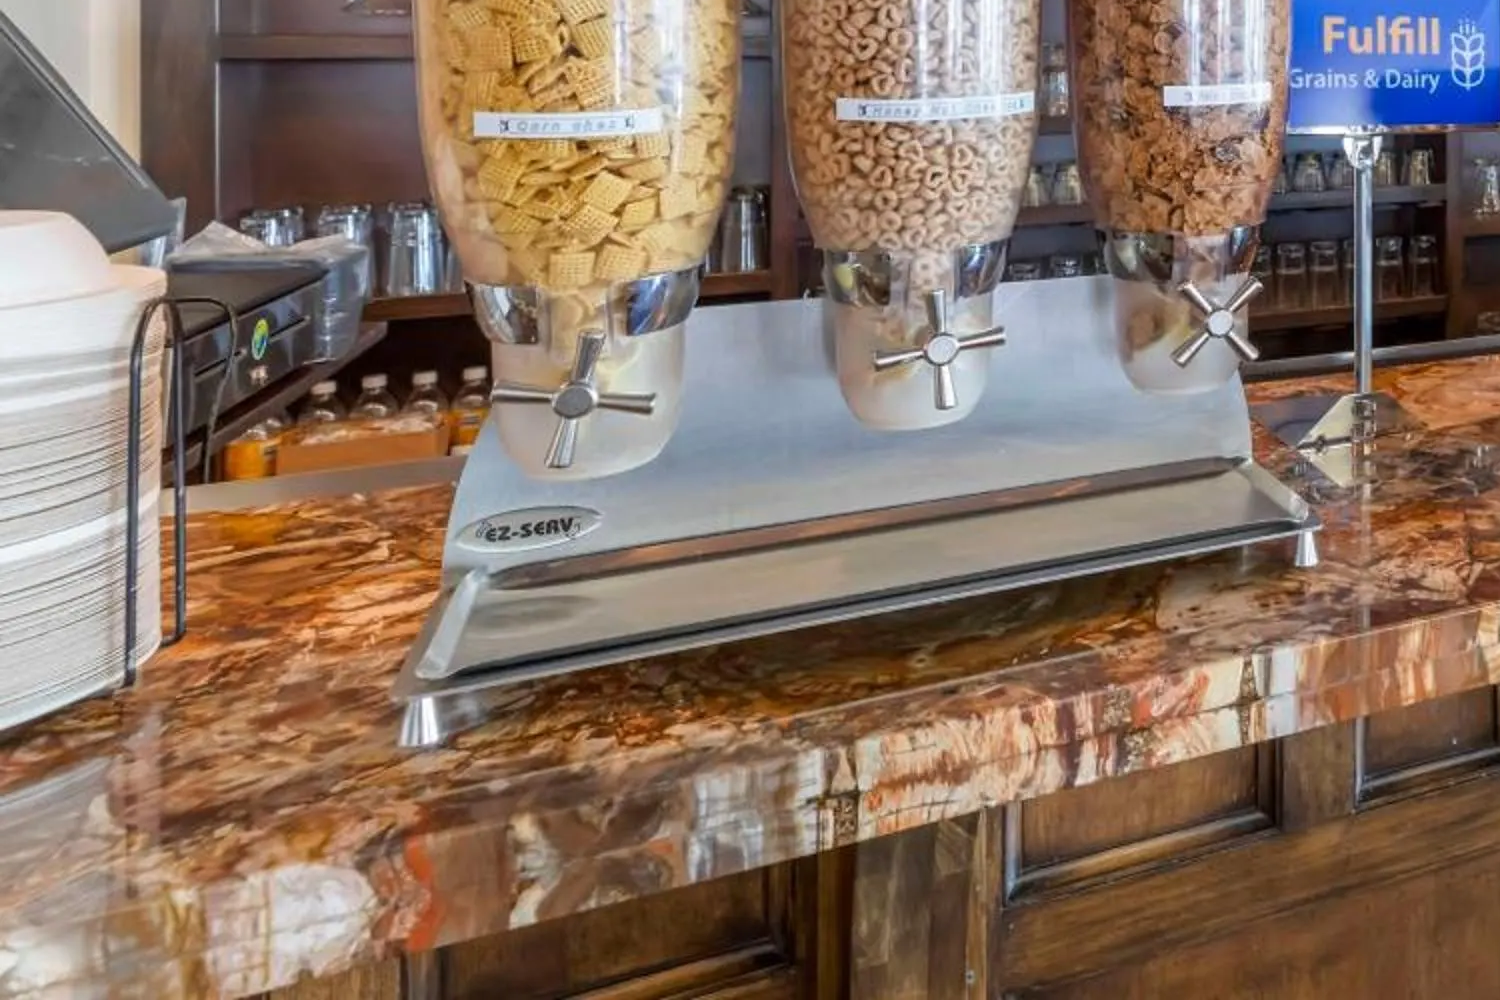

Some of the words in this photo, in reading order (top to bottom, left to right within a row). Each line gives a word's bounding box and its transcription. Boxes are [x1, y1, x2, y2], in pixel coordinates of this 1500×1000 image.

[1322, 15, 1440, 56] Fulfill
[1289, 68, 1359, 89] Grains
[1364, 70, 1380, 89] &
[1385, 69, 1441, 94] Dairy
[485, 516, 574, 543] EZ-SERV
